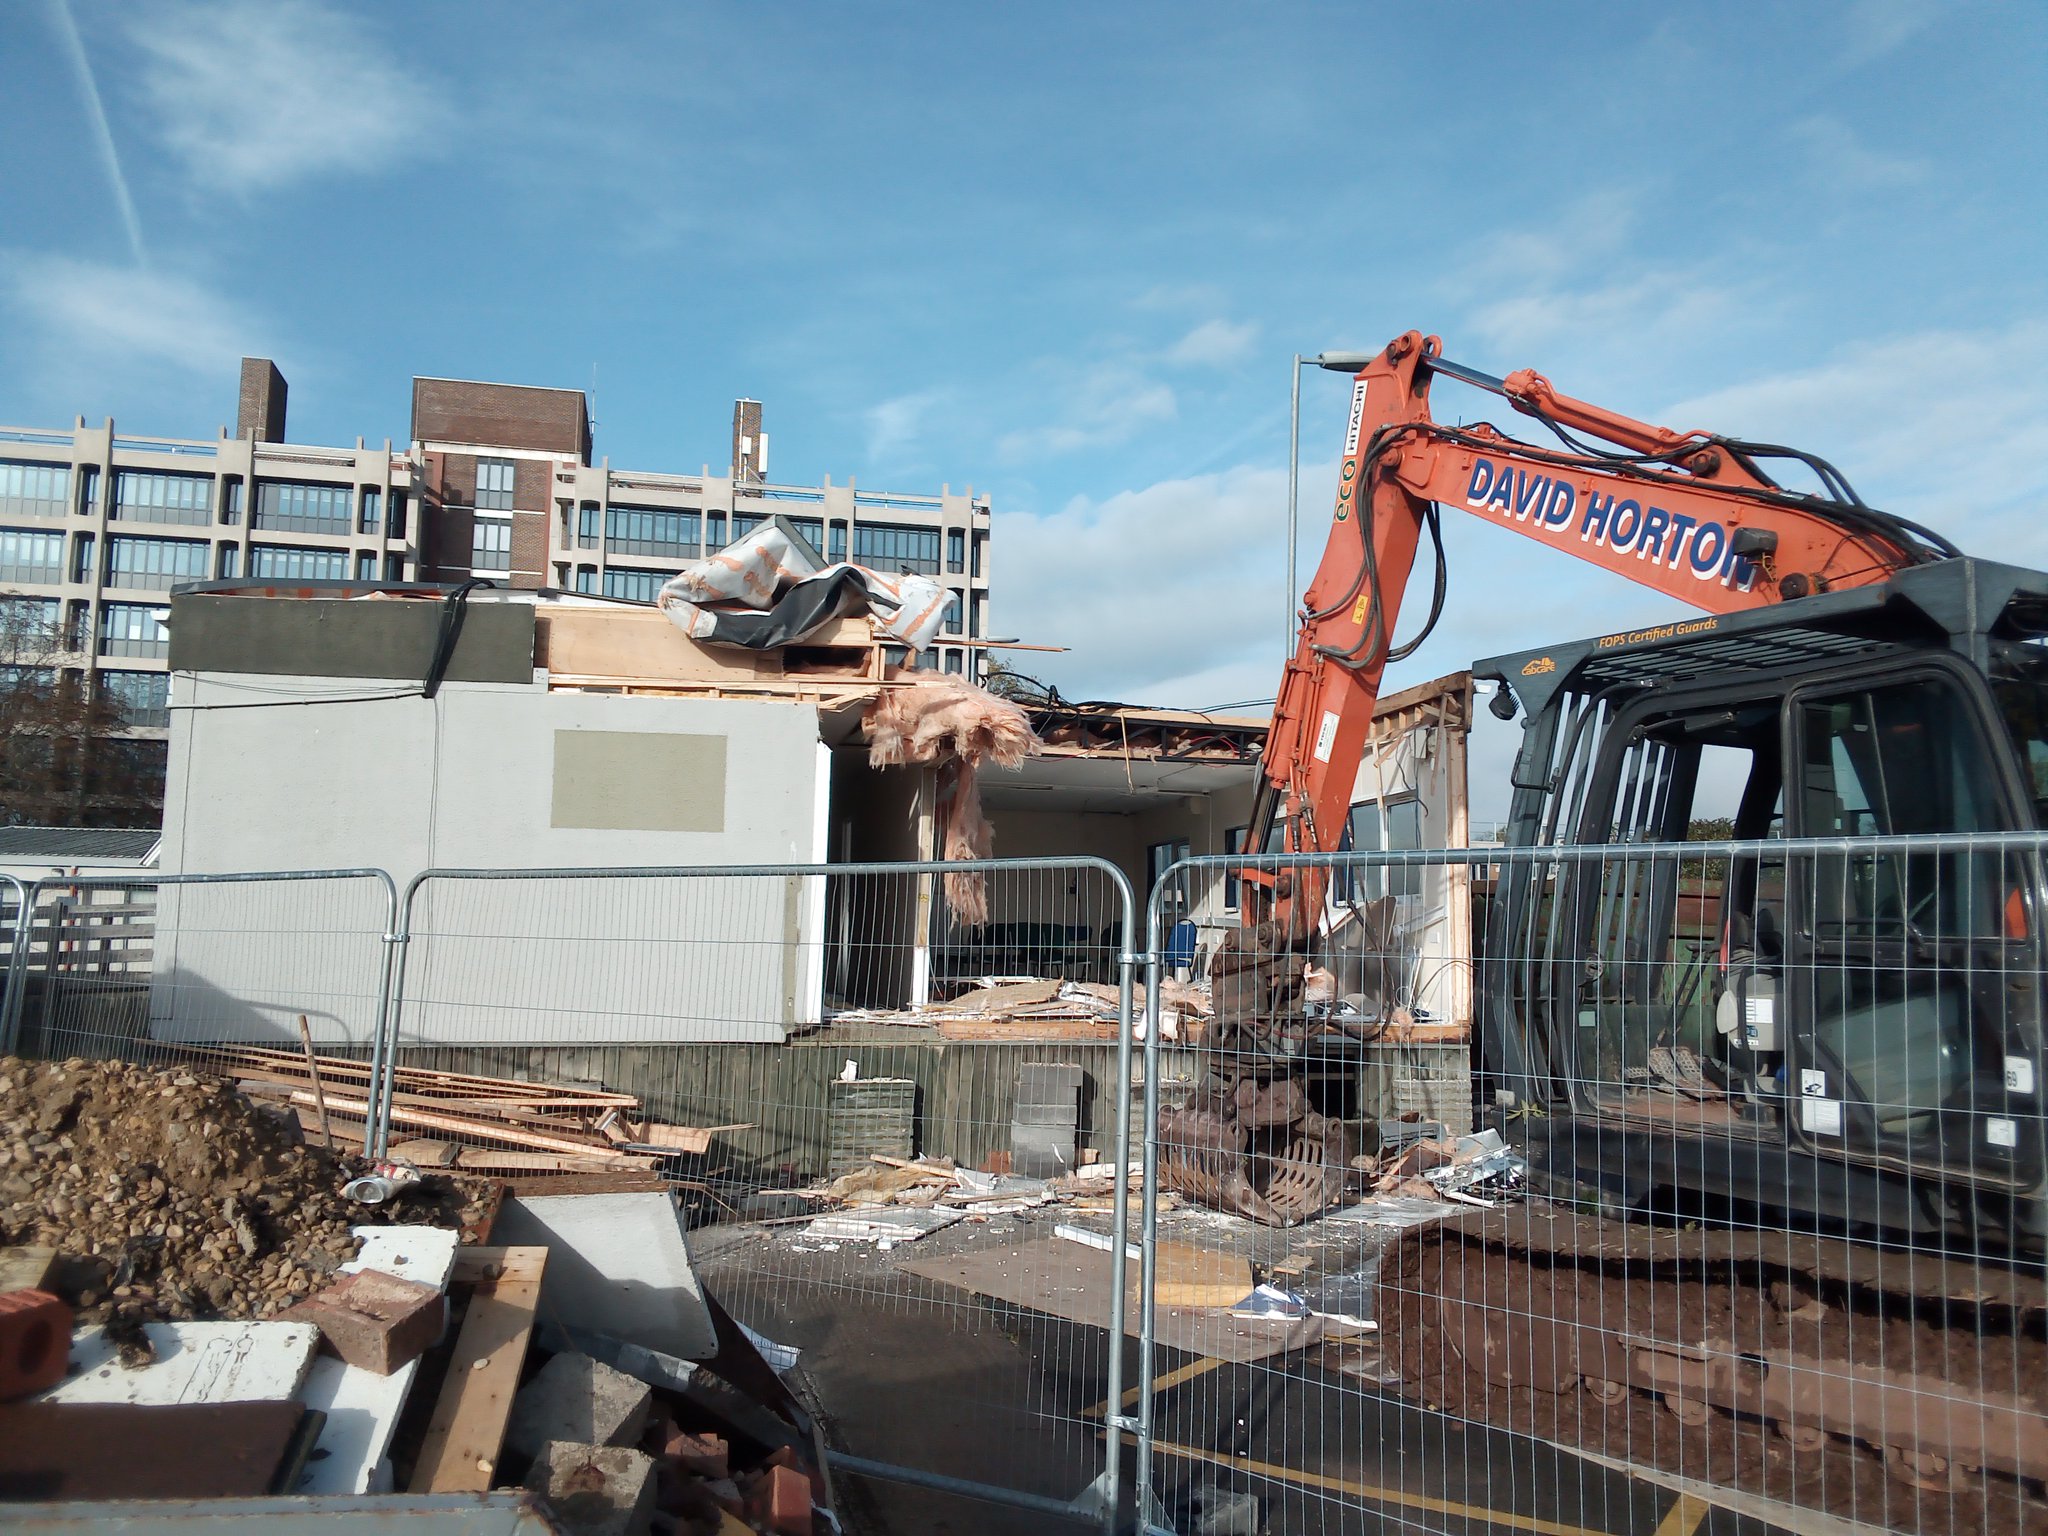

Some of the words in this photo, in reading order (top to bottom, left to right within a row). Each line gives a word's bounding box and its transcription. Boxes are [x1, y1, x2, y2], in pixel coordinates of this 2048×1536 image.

[1348, 385, 1364, 451] HITACHI
[1466, 458, 1576, 533] DAVID
[1599, 634, 1625, 648] FOPS
[1628, 625, 1674, 643] Certified
[1676, 617, 1718, 635] Guards
